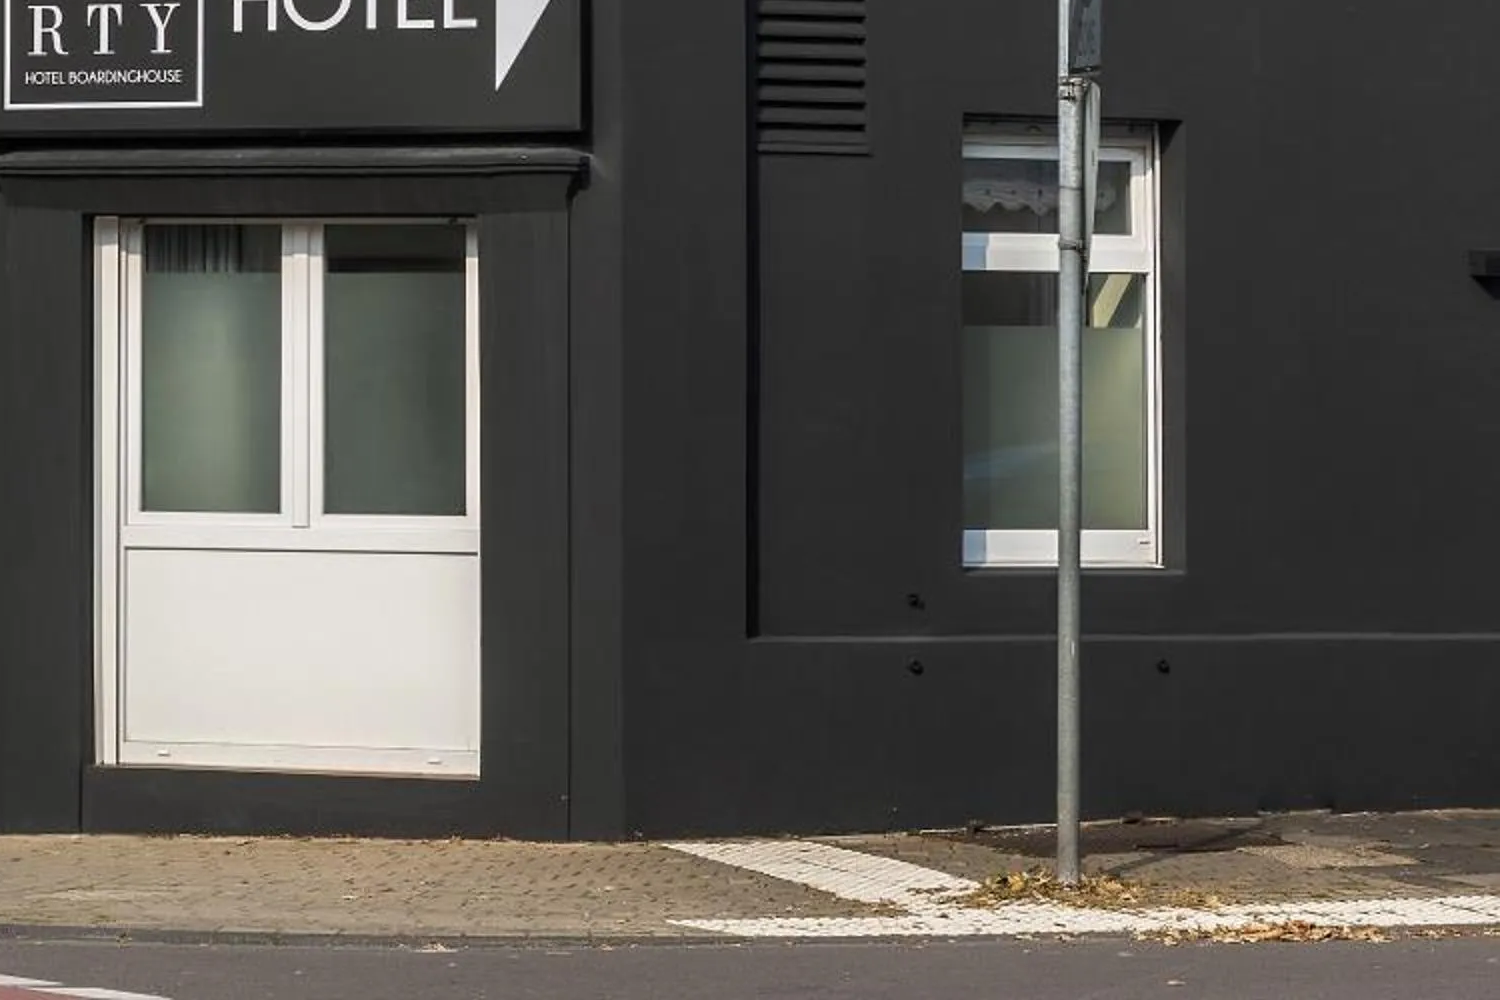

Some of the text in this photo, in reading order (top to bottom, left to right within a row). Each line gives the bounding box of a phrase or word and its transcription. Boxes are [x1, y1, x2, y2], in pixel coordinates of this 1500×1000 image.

[27, 2, 182, 56] RTY
[24, 69, 183, 85] HOTEL BOARDINGHOUSE
